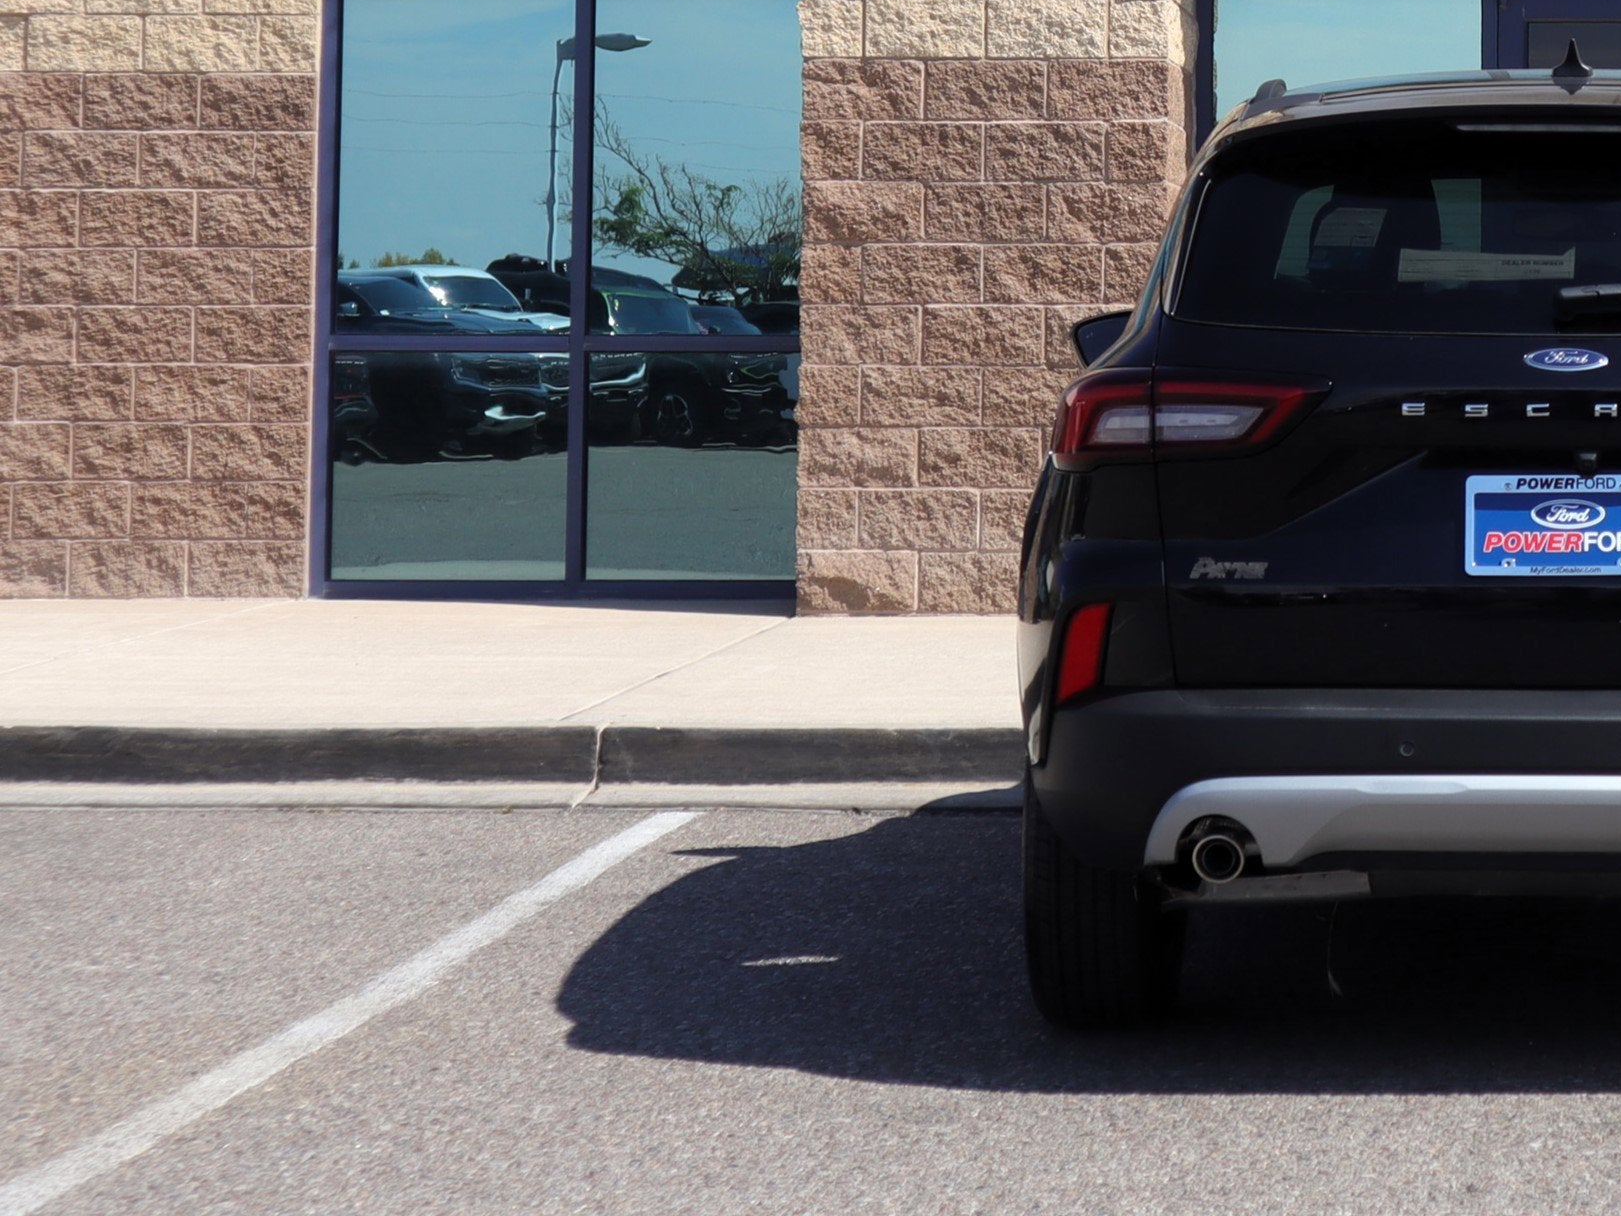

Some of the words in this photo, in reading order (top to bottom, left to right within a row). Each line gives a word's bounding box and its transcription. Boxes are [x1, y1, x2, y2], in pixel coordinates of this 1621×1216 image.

[1544, 350, 1589, 364] Ford
[1516, 477, 1616, 490] POWERFORD
[1546, 503, 1590, 523] Ford
